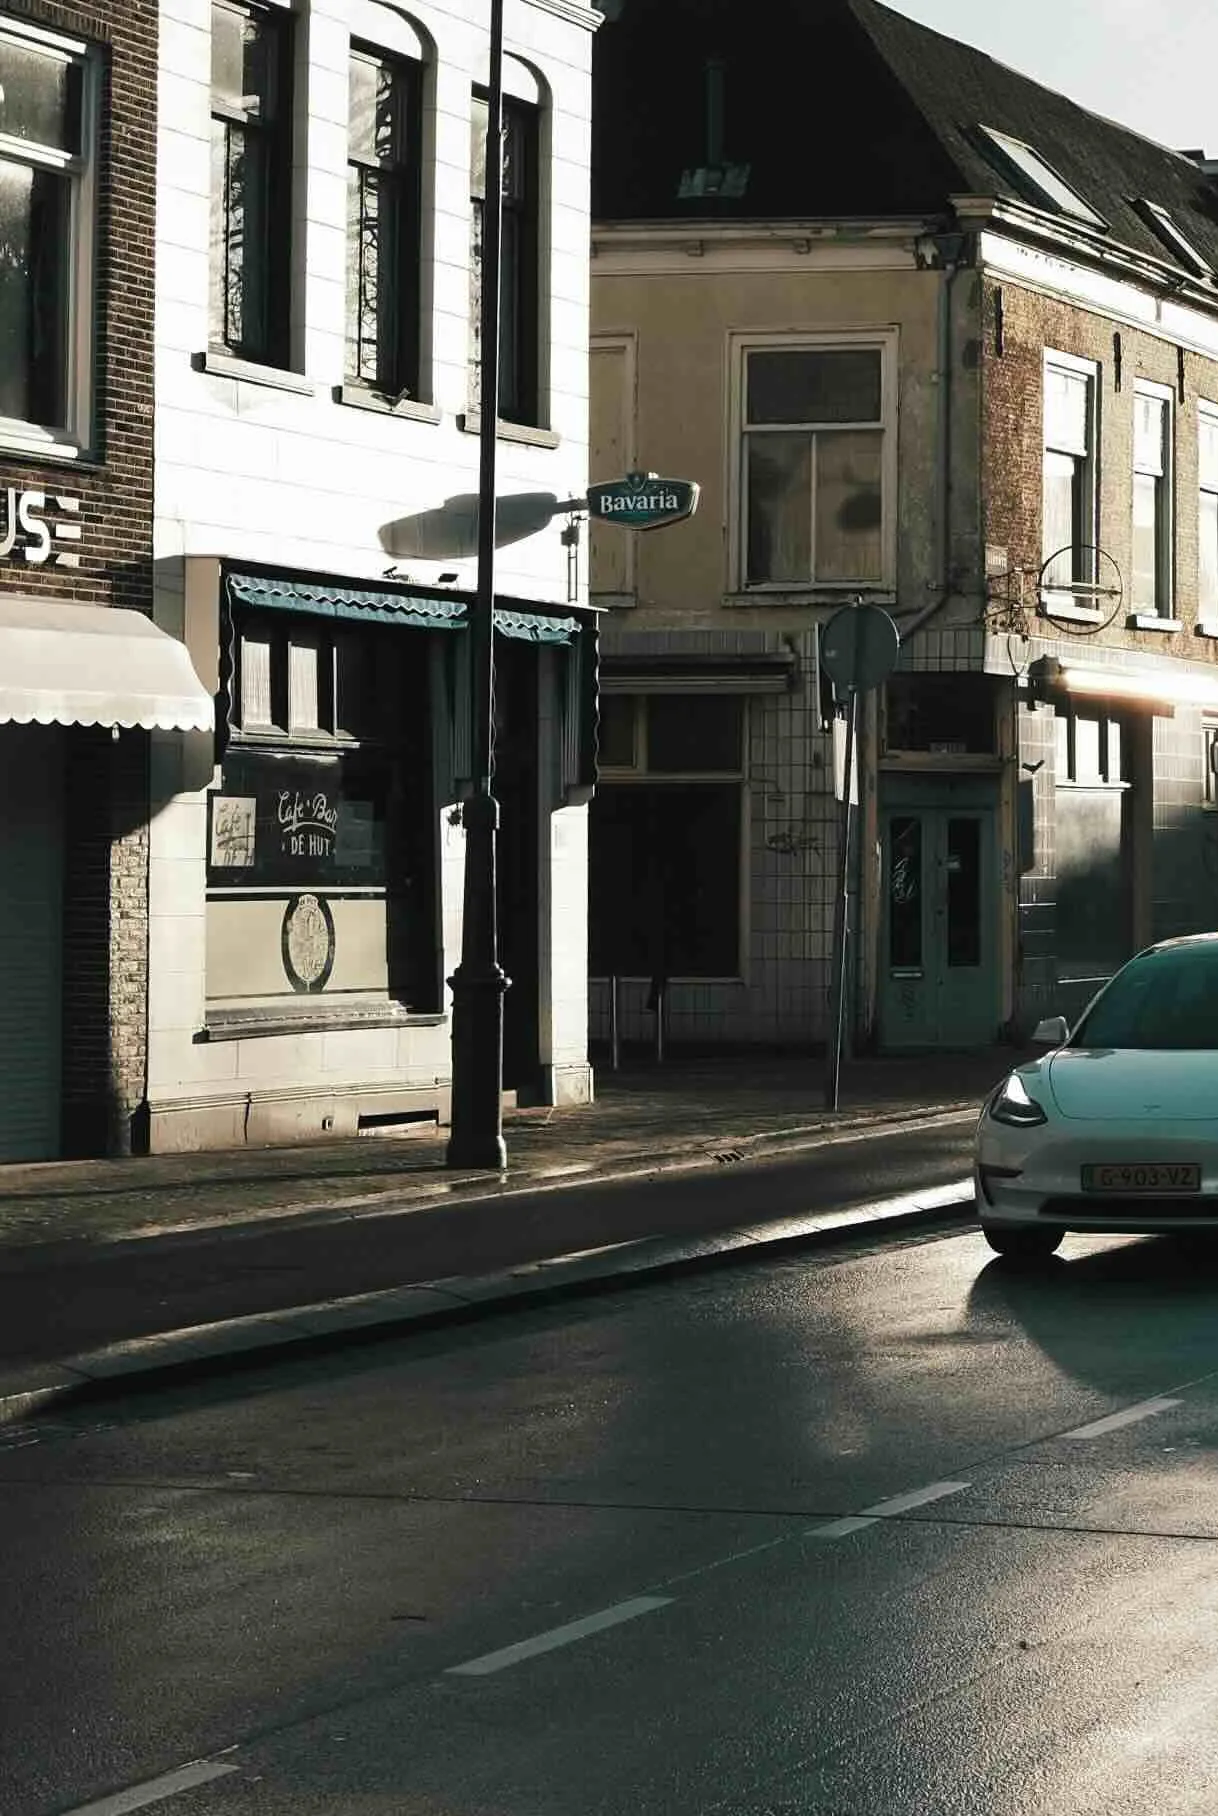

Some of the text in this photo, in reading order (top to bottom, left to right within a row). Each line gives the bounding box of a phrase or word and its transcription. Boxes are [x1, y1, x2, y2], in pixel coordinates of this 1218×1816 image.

[600, 490, 679, 514] Bavaria
[309, 793, 339, 829] Bar
[291, 833, 331, 857] DE HUT
